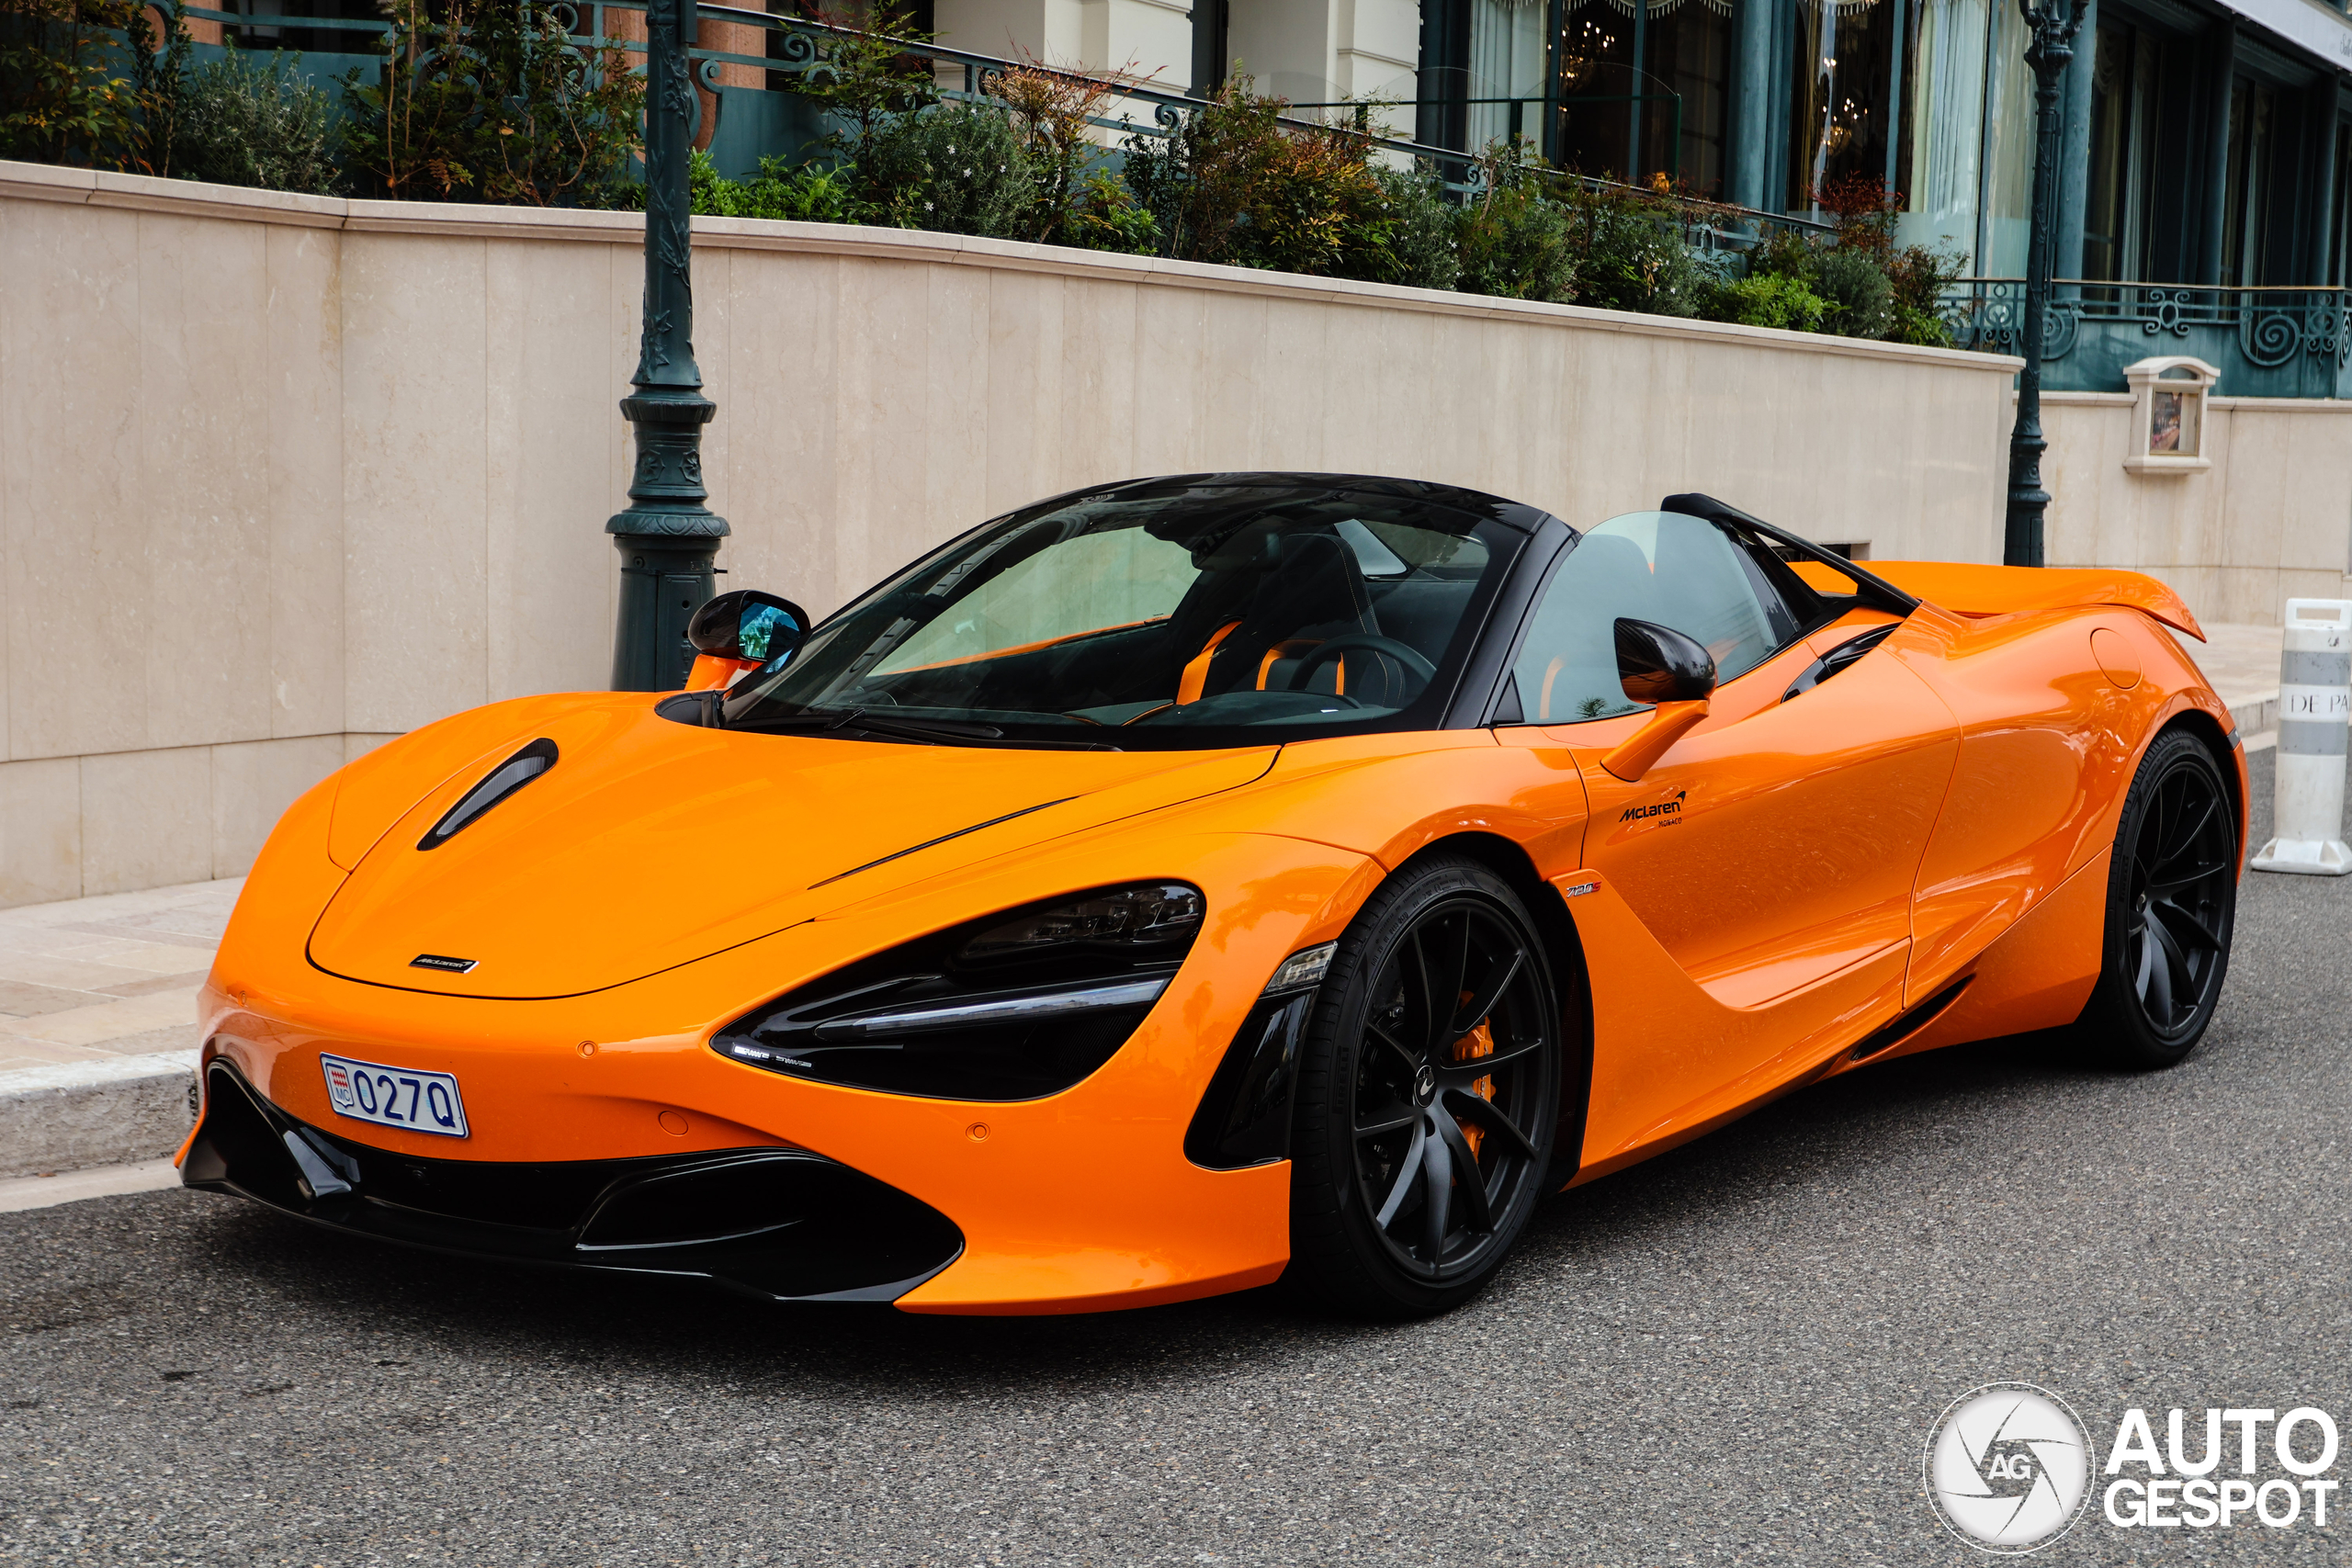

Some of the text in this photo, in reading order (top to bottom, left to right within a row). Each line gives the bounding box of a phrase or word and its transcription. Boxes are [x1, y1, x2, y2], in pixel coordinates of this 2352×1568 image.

[2291, 694, 2350, 714] DE PA
[1619, 801, 1681, 823] McLaren
[1658, 817, 1682, 828] MONACO
[1566, 881, 1602, 898] 720S
[416, 958, 464, 968] McLaren
[334, 1069, 457, 1128] MC 027Q
